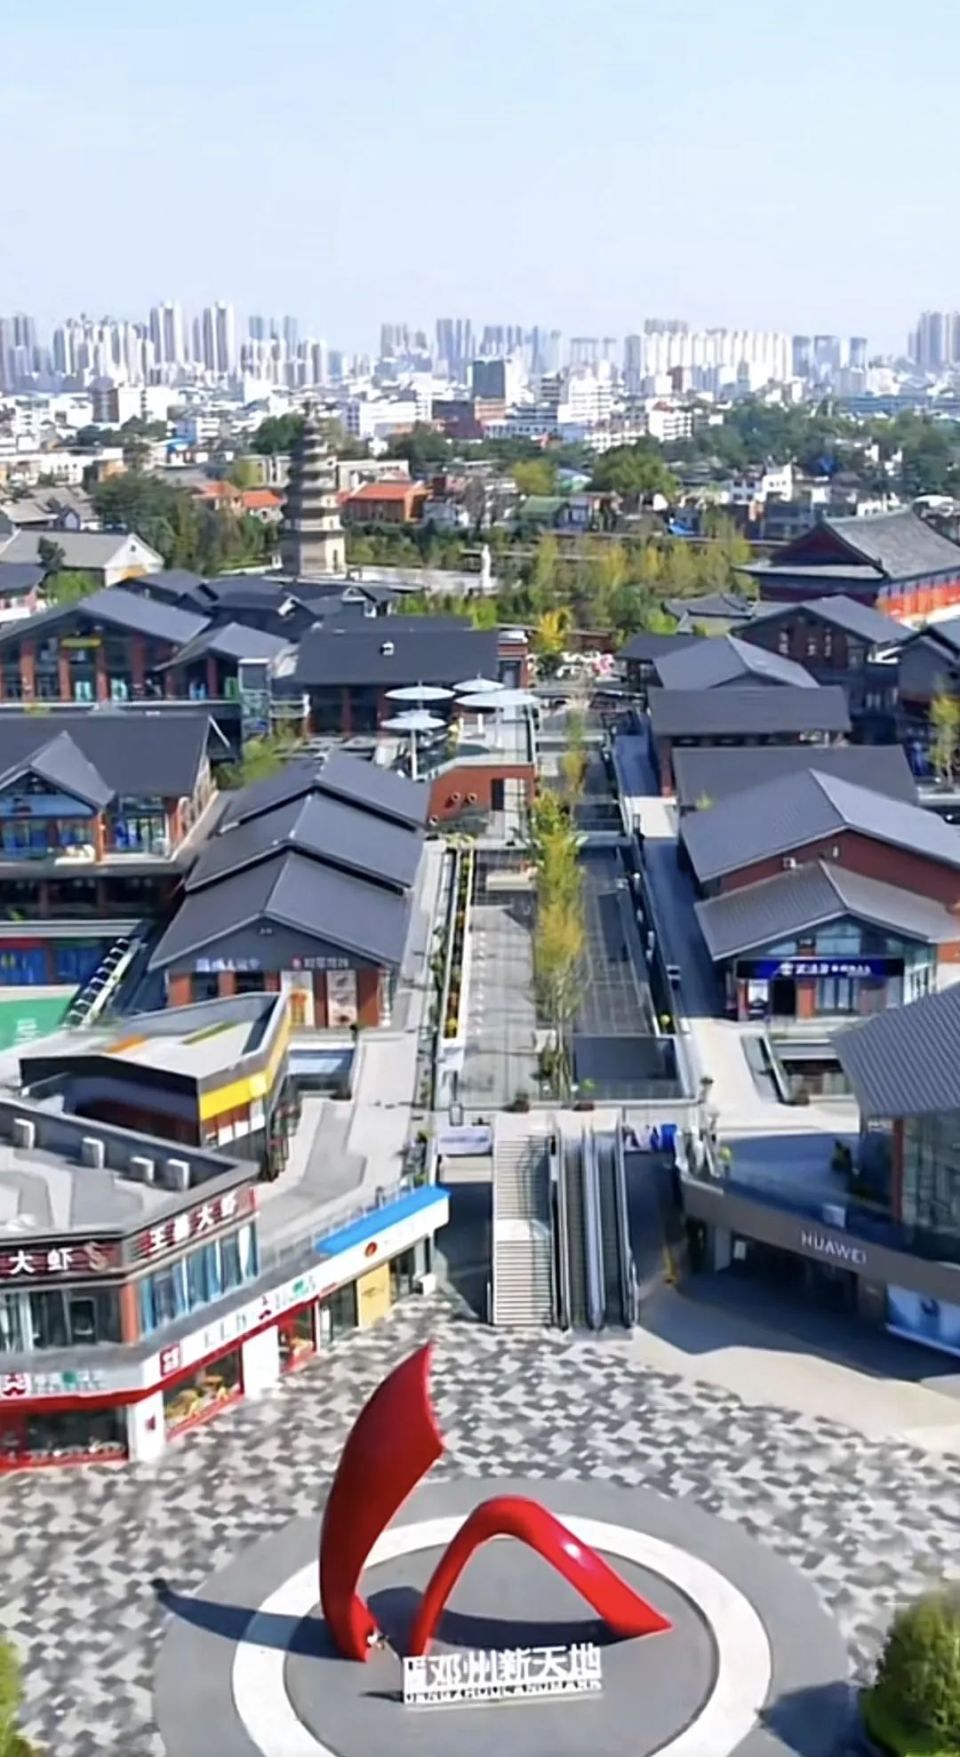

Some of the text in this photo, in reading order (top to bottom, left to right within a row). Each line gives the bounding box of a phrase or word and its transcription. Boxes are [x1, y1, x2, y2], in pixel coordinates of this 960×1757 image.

[8, 1247, 73, 1275] 大虾
[800, 1231, 868, 1264] HUAWEI
[428, 1643, 602, 1688] 邓州新天地
